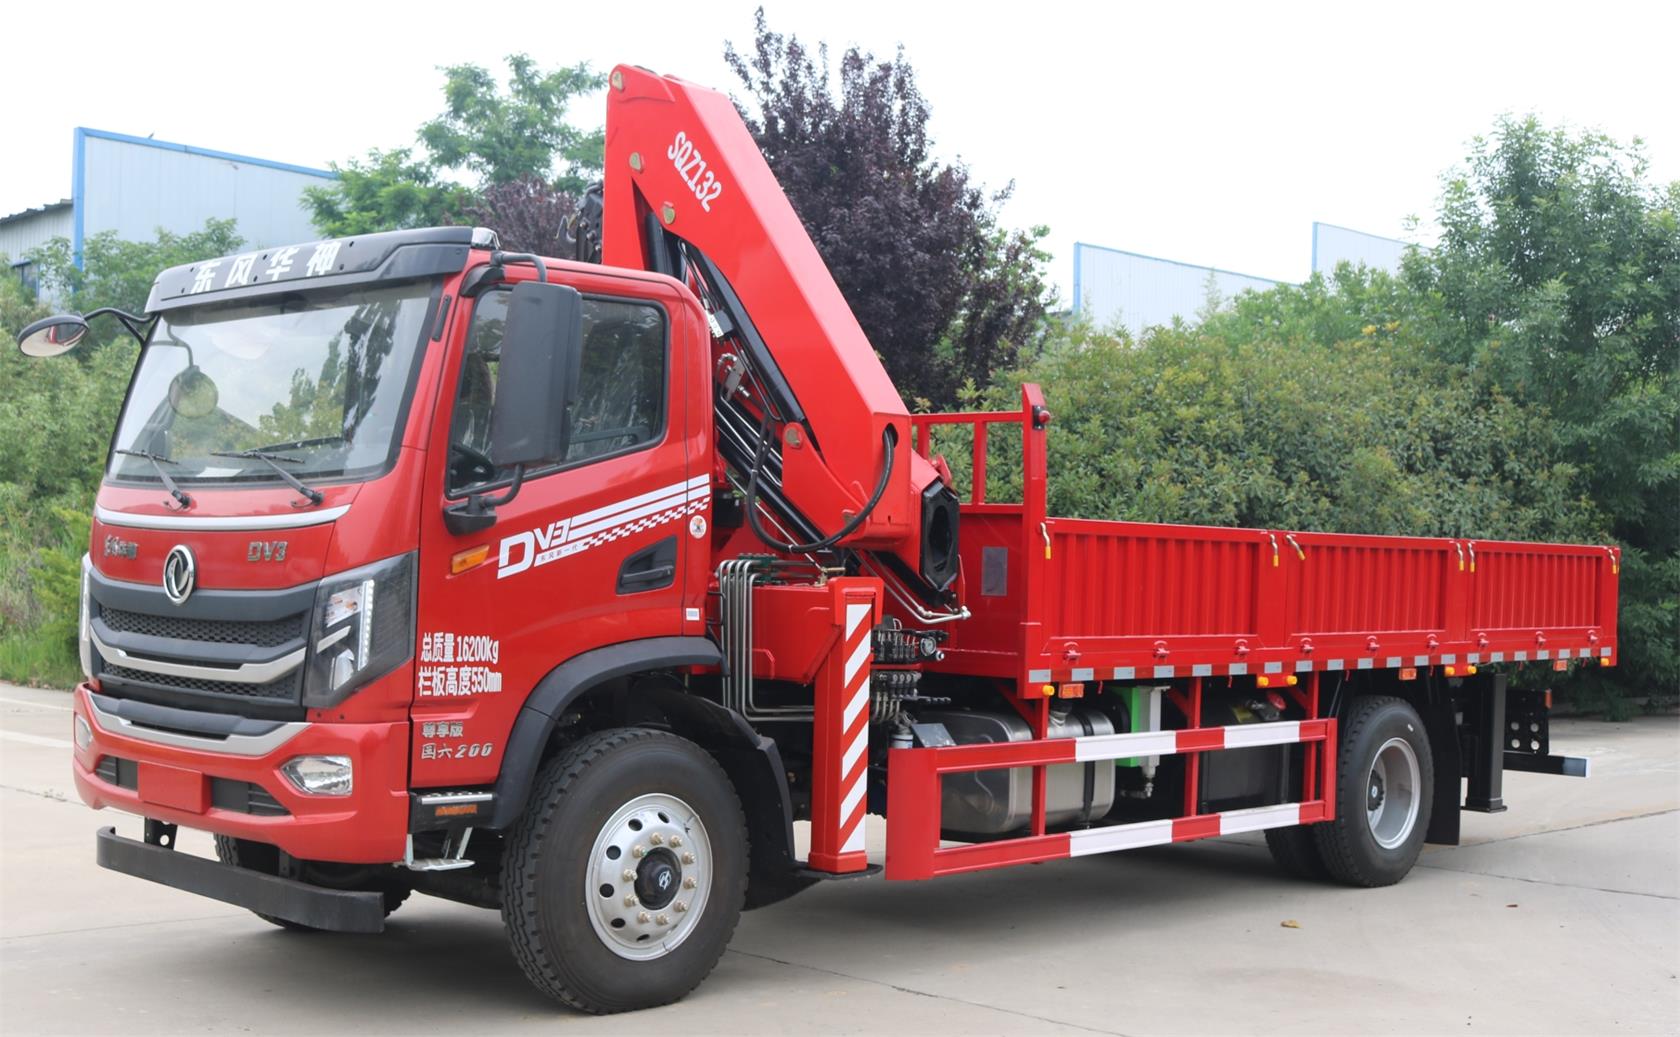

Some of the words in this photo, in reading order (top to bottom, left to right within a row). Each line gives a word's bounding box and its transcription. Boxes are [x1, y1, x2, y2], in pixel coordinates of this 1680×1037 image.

[667, 131, 722, 212] SQZ132
[190, 241, 341, 295] 东风华神
[247, 540, 289, 561] DV3
[418, 665, 503, 697] 栏板高度550mm
[422, 721, 464, 738] 尊享版
